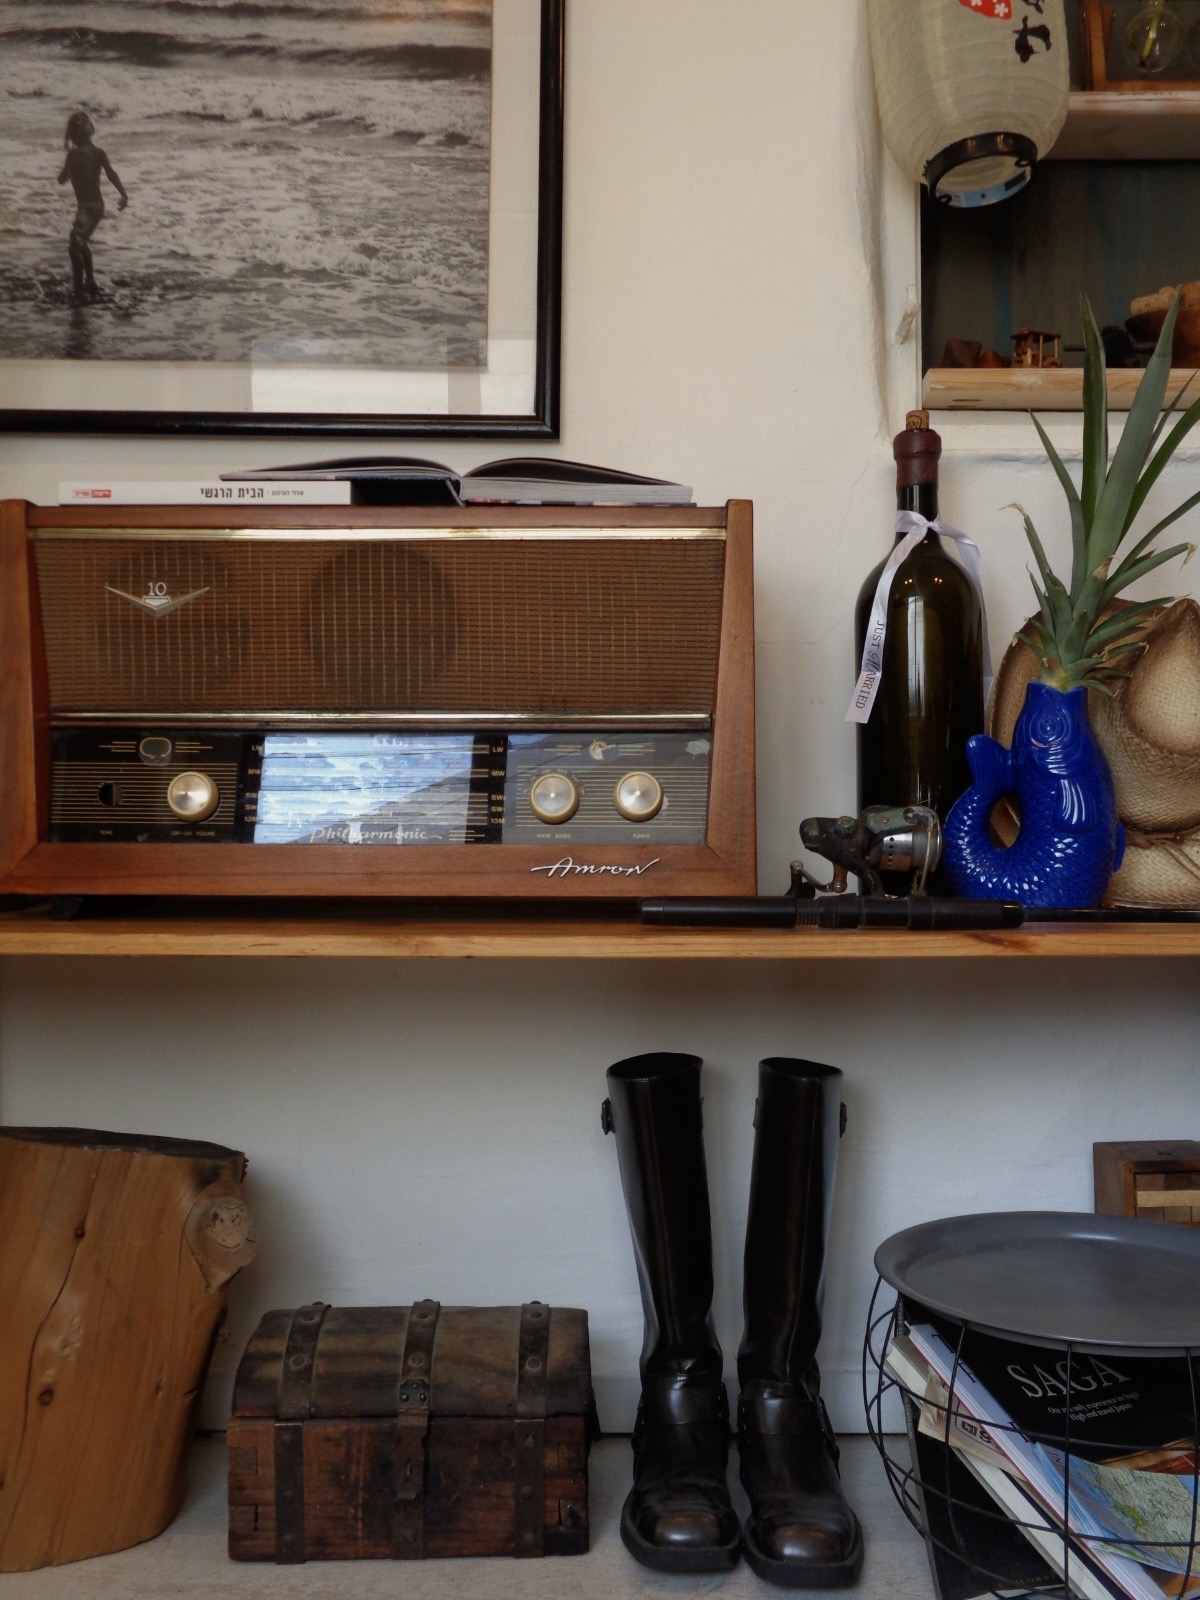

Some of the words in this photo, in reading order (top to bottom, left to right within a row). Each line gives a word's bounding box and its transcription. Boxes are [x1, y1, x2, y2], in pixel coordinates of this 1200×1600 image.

[200, 488, 233, 498] הרגשי
[238, 488, 264, 498] הבית
[147, 583, 167, 596] 10
[871, 620, 884, 649] JUST
[855, 650, 882, 709] MARRIED
[1006, 1355, 1131, 1398] SAGA
